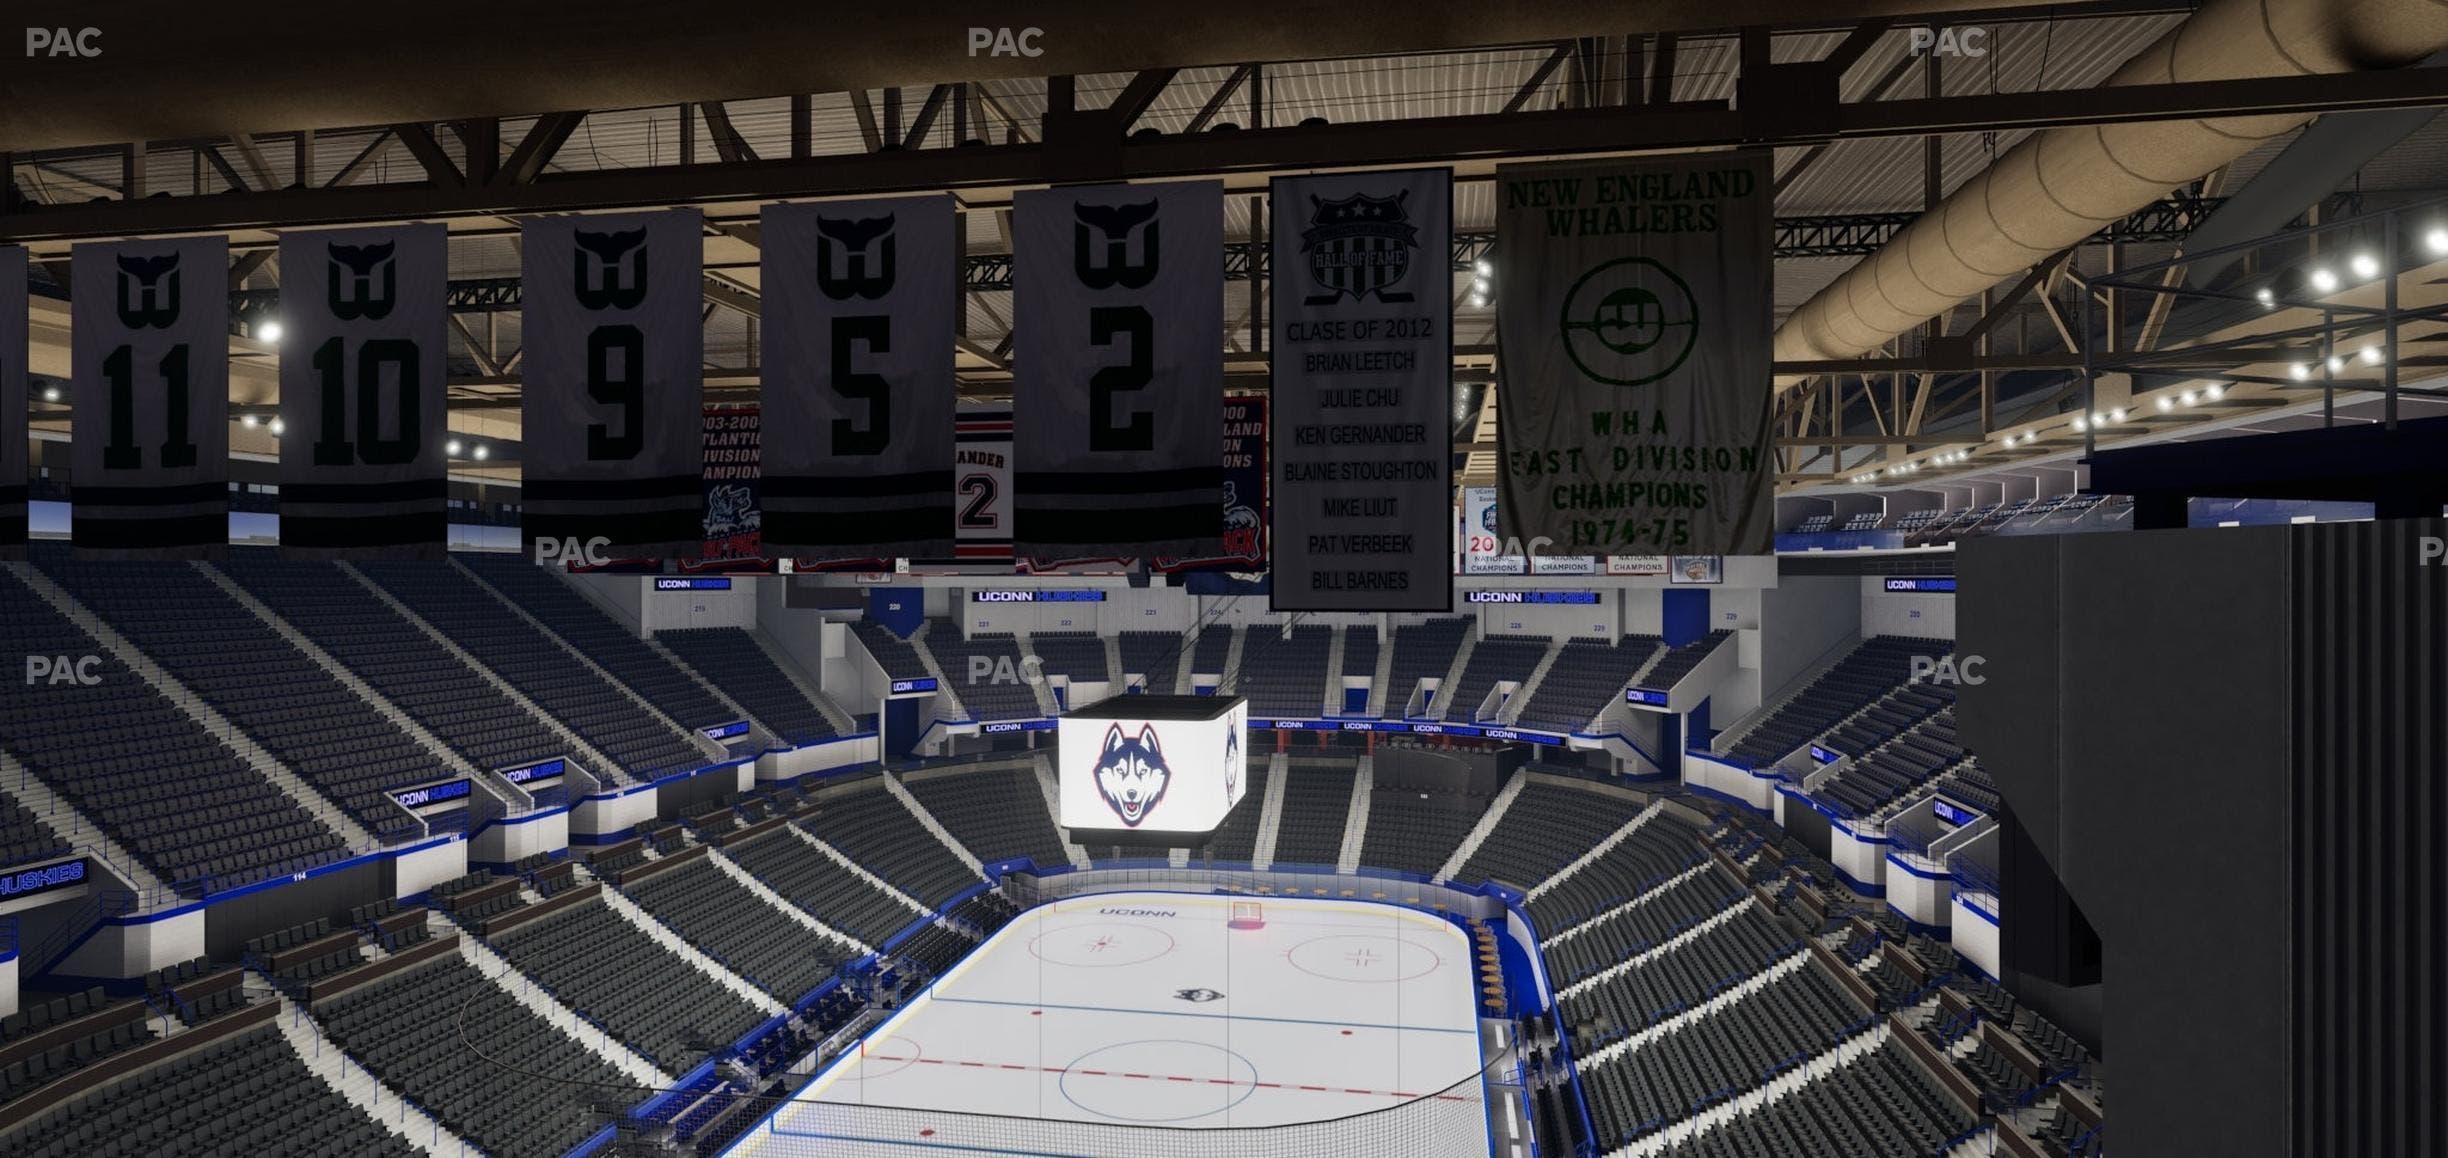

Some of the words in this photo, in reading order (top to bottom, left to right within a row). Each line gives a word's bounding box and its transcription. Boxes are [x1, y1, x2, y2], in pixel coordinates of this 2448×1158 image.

[1508, 179, 1582, 208] NEW
[1597, 169, 1754, 203] ENGLAND
[1547, 204, 1718, 236] WHALERS
[1315, 253, 1345, 268] HALL
[1350, 251, 1366, 267] OF
[1368, 250, 1405, 266] FAME
[1287, 322, 1346, 341] CLASE
[1353, 320, 1378, 339] OF
[1385, 318, 1432, 338] 2012
[1306, 353, 1351, 372] BRIAN
[1355, 351, 1415, 371] LEETCH
[831, 316, 890, 456] 5
[1089, 306, 1153, 451] 2
[312, 337, 420, 465] 10
[588, 325, 643, 460] 9
[1321, 389, 1363, 407] JULIE
[1366, 388, 1399, 407] CHU
[103, 345, 197, 469] 11
[1224, 422, 1262, 436] LAND
[1296, 426, 1326, 444] KEN
[1330, 425, 1425, 444] GERNANDER
[957, 451, 1004, 469] ANDER
[1224, 454, 1253, 468] ONS
[1511, 448, 1582, 476] EAST
[1613, 446, 1756, 472] DIVISION
[1285, 463, 1337, 480] BLAINE
[1341, 461, 1437, 480] STOUGHTON
[1553, 482, 1708, 509] CHAMPIONS
[1324, 498, 1361, 517] MIKE
[1364, 497, 1398, 516] LIUT
[1572, 520, 1689, 545] 1974-75
[1308, 535, 1338, 553] PAT
[1341, 534, 1413, 553] VERBEEK
[1541, 563, 1588, 571] CHAMPIONS
[1614, 563, 1663, 571] CHAMPIONS
[658, 580, 690, 588] UCONN
[1312, 571, 1343, 589] BILL
[1347, 571, 1409, 589] BARNES
[1887, 581, 1916, 589] UCONN
[979, 592, 1033, 601] UCONN
[1469, 592, 1522, 602] UCONN
[986, 724, 1022, 732] UCONN
[1275, 721, 1303, 729] UCONN
[1343, 722, 1372, 730] UCONN
[1413, 724, 1442, 732] UCONN
[1486, 729, 1518, 739] UCONN
[1100, 908, 1176, 918] UCONN
